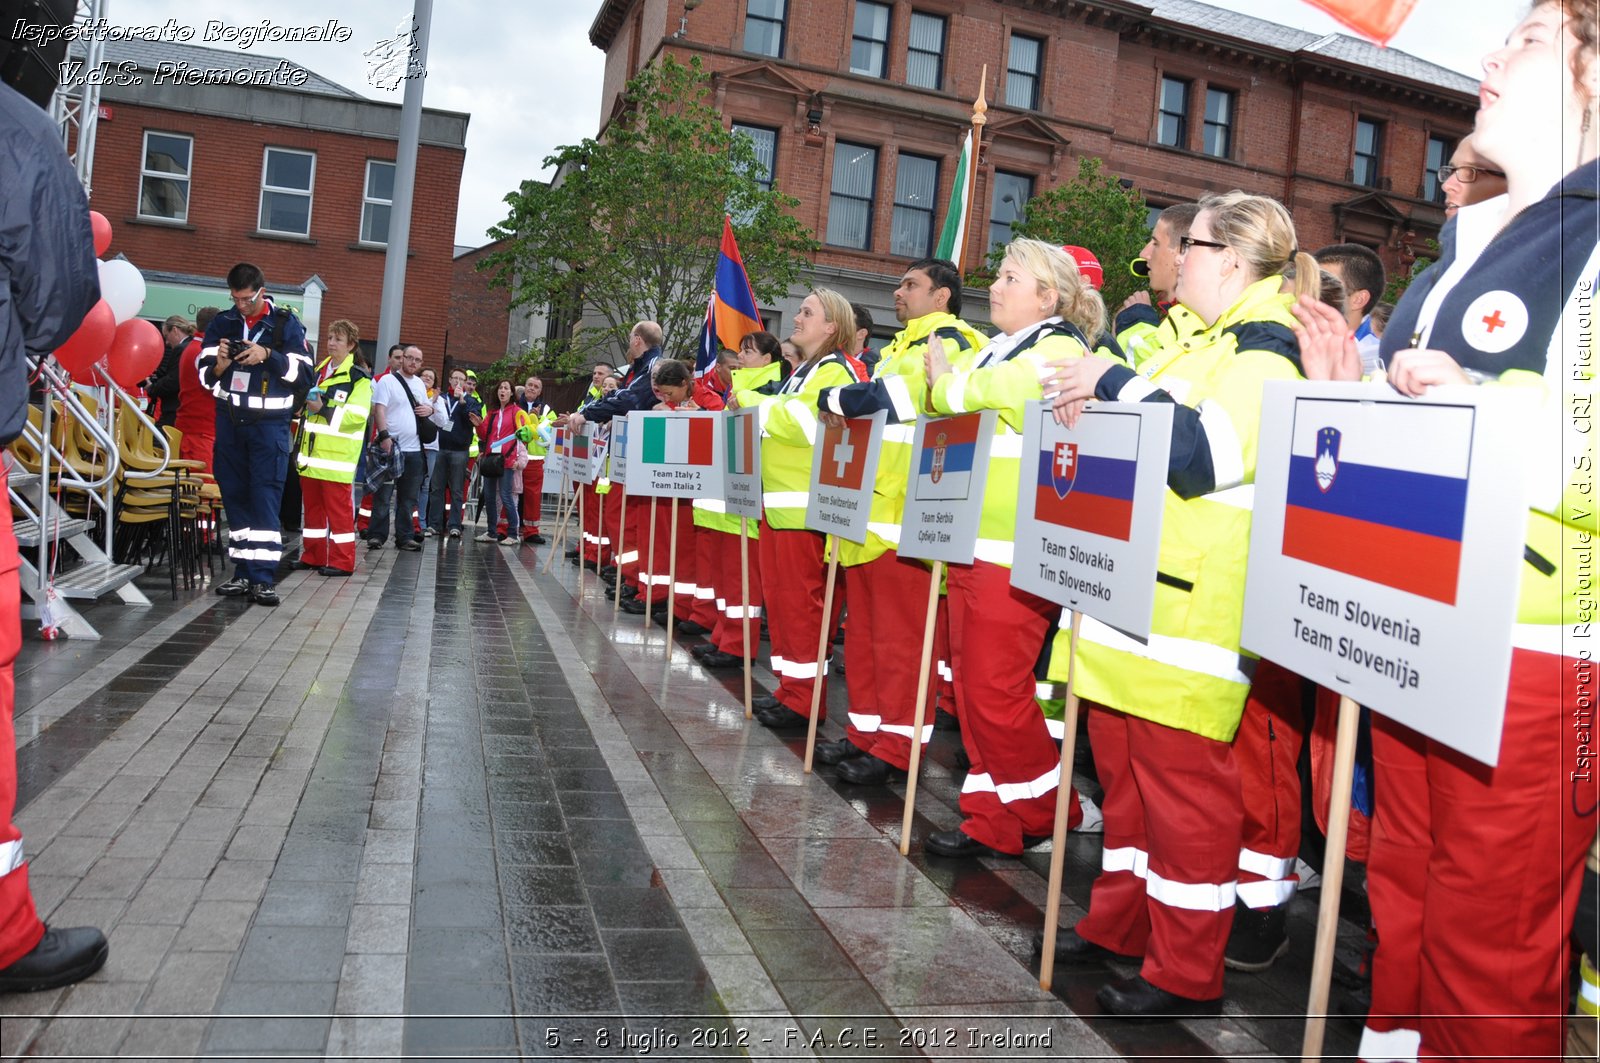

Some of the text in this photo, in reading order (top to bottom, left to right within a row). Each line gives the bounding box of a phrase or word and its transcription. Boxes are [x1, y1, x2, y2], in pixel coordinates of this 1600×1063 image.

[653, 469, 701, 481] Team Italy 2
[651, 480, 702, 491] Team Italia 2
[817, 492, 859, 511] Team Switzerland
[818, 509, 852, 527] Team Schweiz
[921, 511, 954, 524] Team Serbia
[1041, 536, 1115, 573] Team Slovakia
[1058, 570, 1112, 602] Slovensko
[1299, 583, 1421, 647] Team Slovenia
[1293, 617, 1420, 690] Team Slovenija
